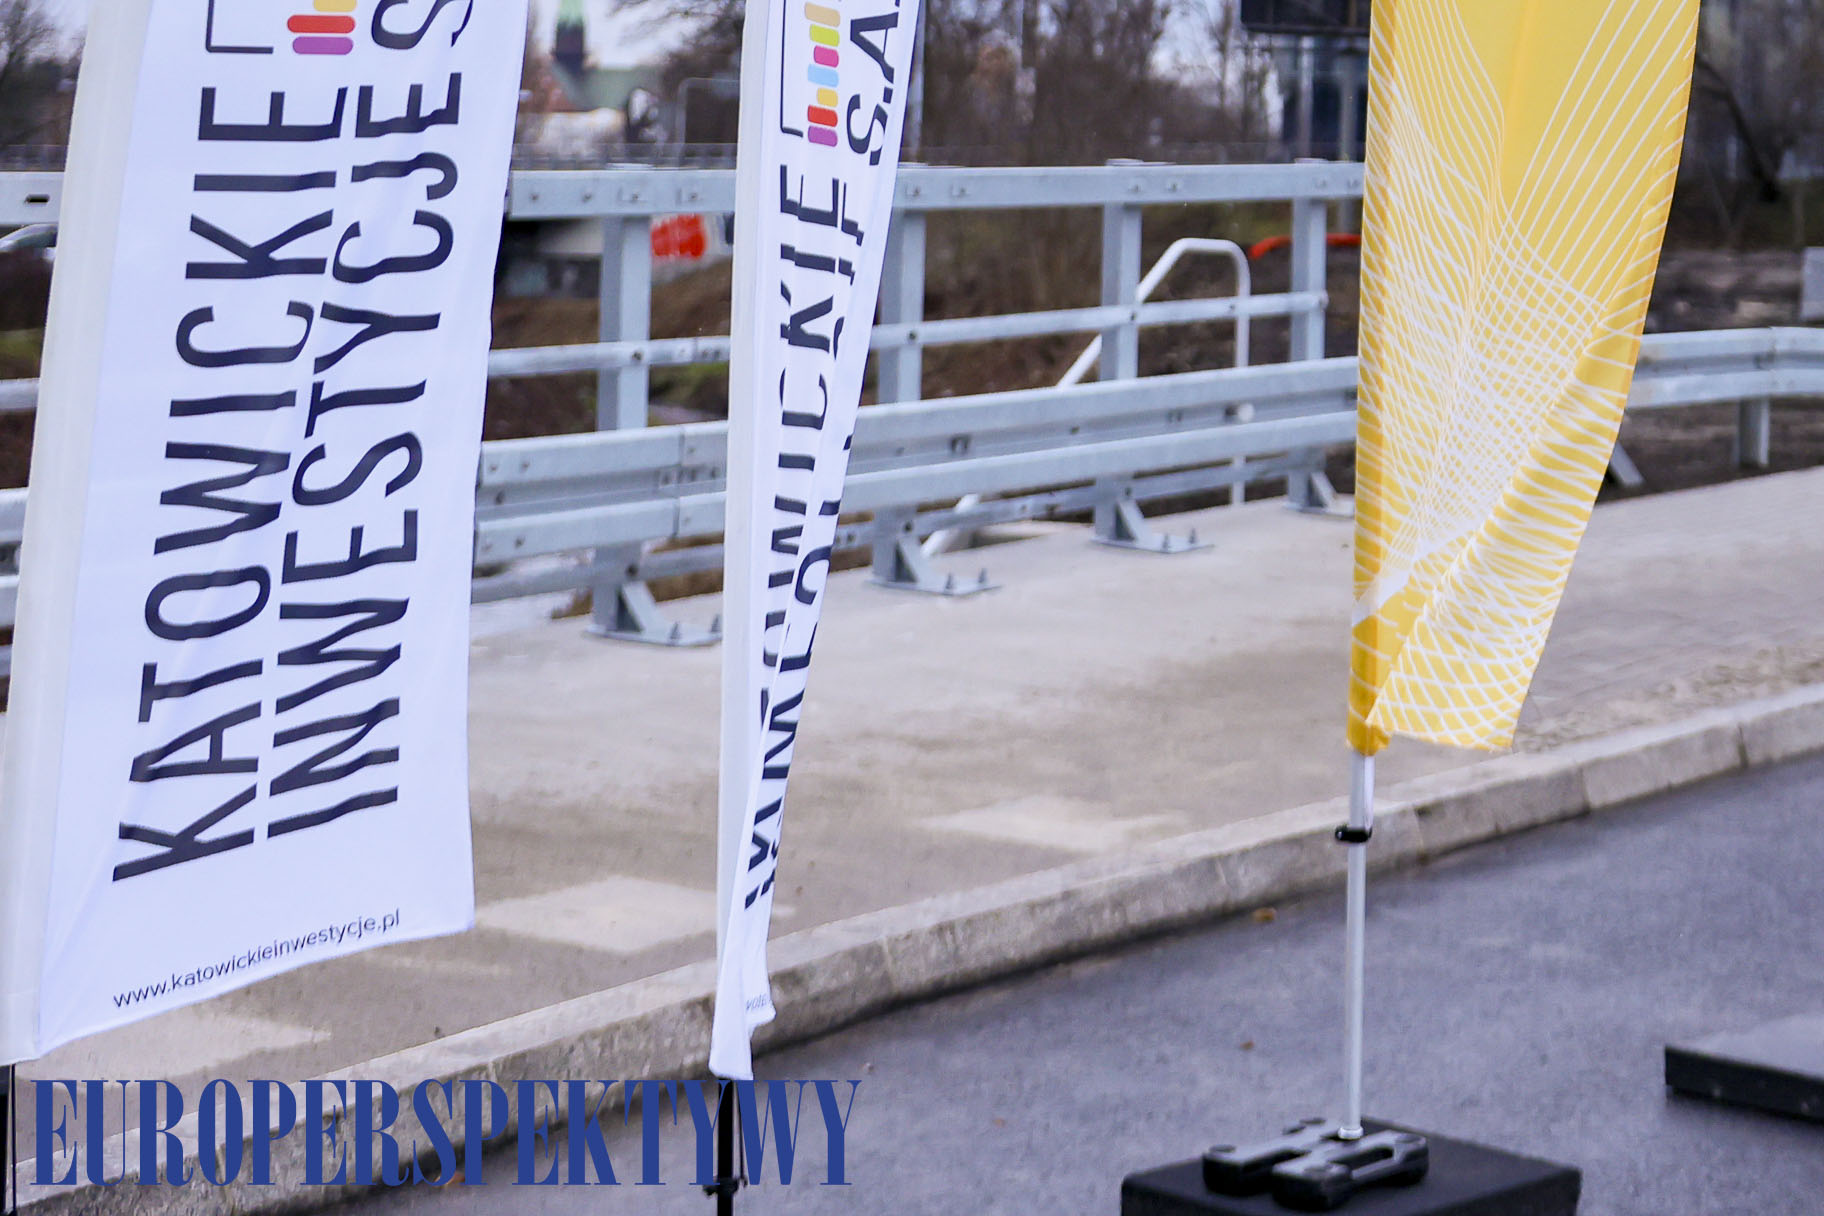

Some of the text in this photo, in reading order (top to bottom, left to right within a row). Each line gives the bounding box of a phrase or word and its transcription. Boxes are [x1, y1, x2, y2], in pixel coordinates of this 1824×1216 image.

[113, 87, 348, 882] KATOWICKIE
[268, 73, 462, 839] INWESTYCJE
[113, 908, 400, 1008] www.katowickieinwestycje.pl
